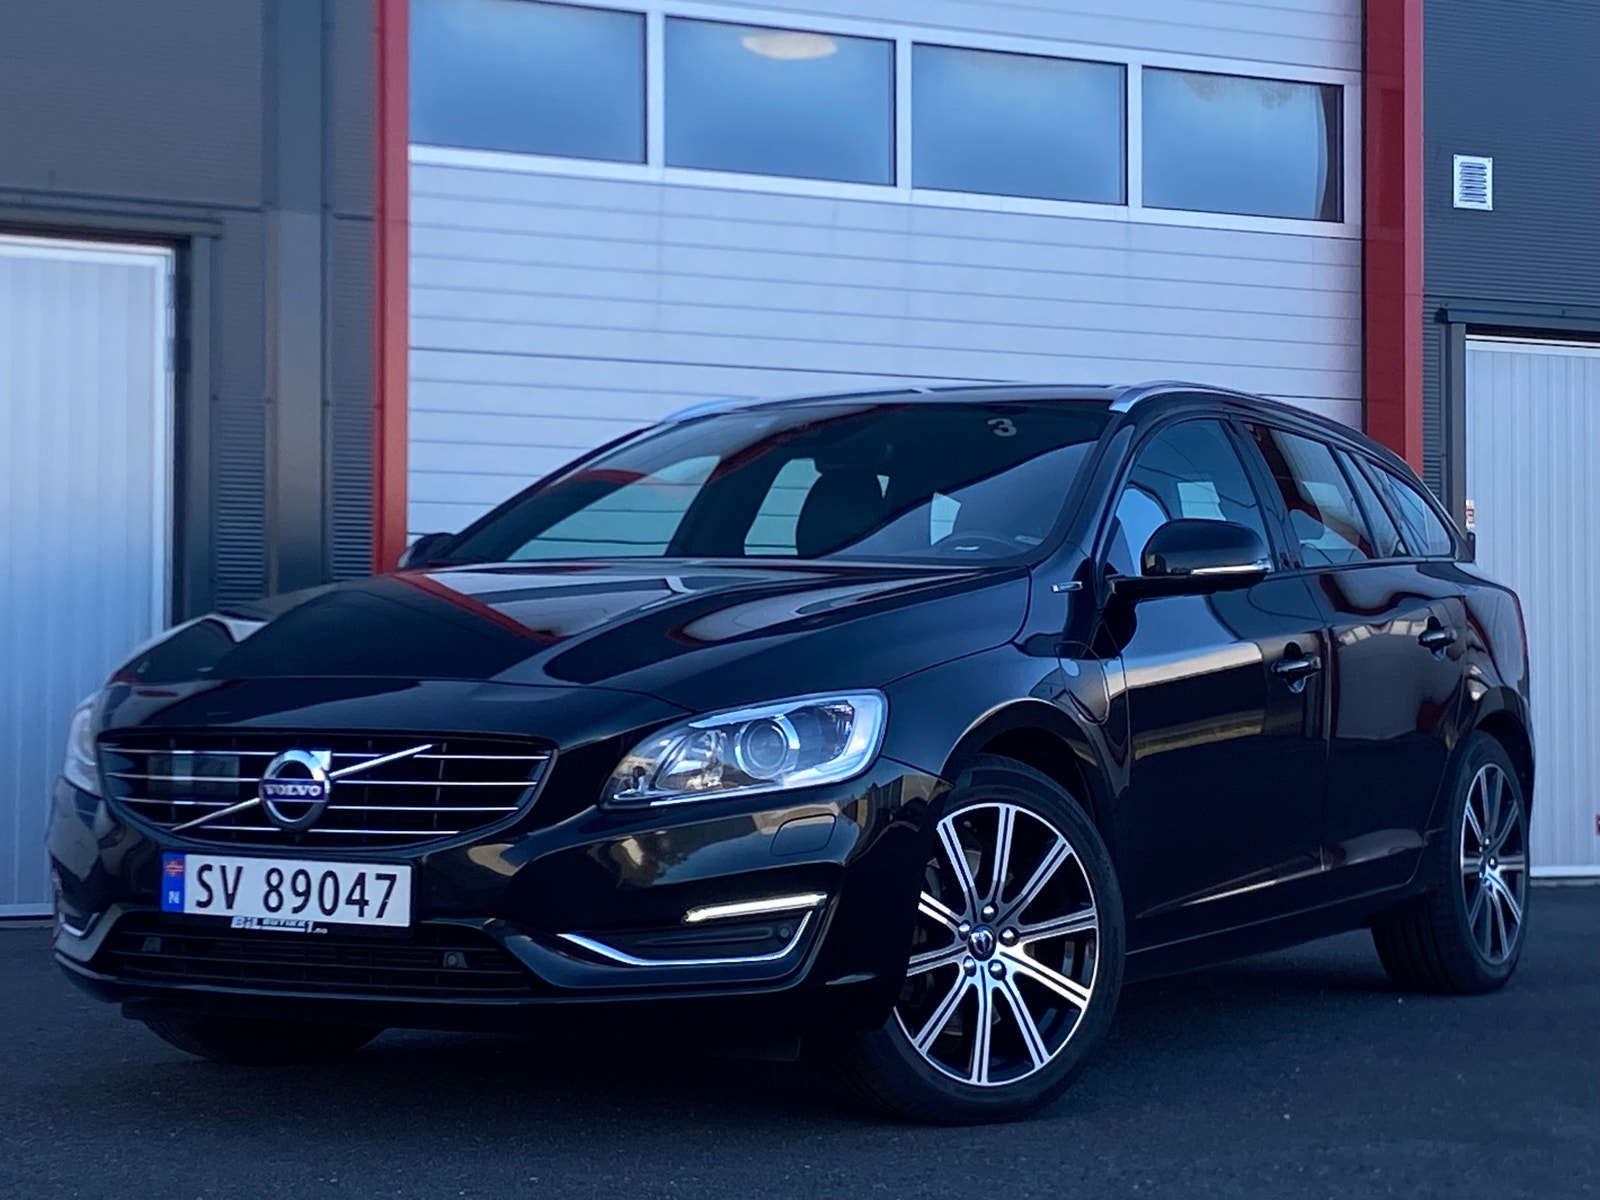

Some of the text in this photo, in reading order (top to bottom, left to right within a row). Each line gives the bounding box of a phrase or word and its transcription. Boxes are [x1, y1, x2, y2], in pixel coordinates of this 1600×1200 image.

[263, 784, 322, 797] VOLVO
[168, 890, 180, 905] N
[195, 863, 398, 919] SV 89047
